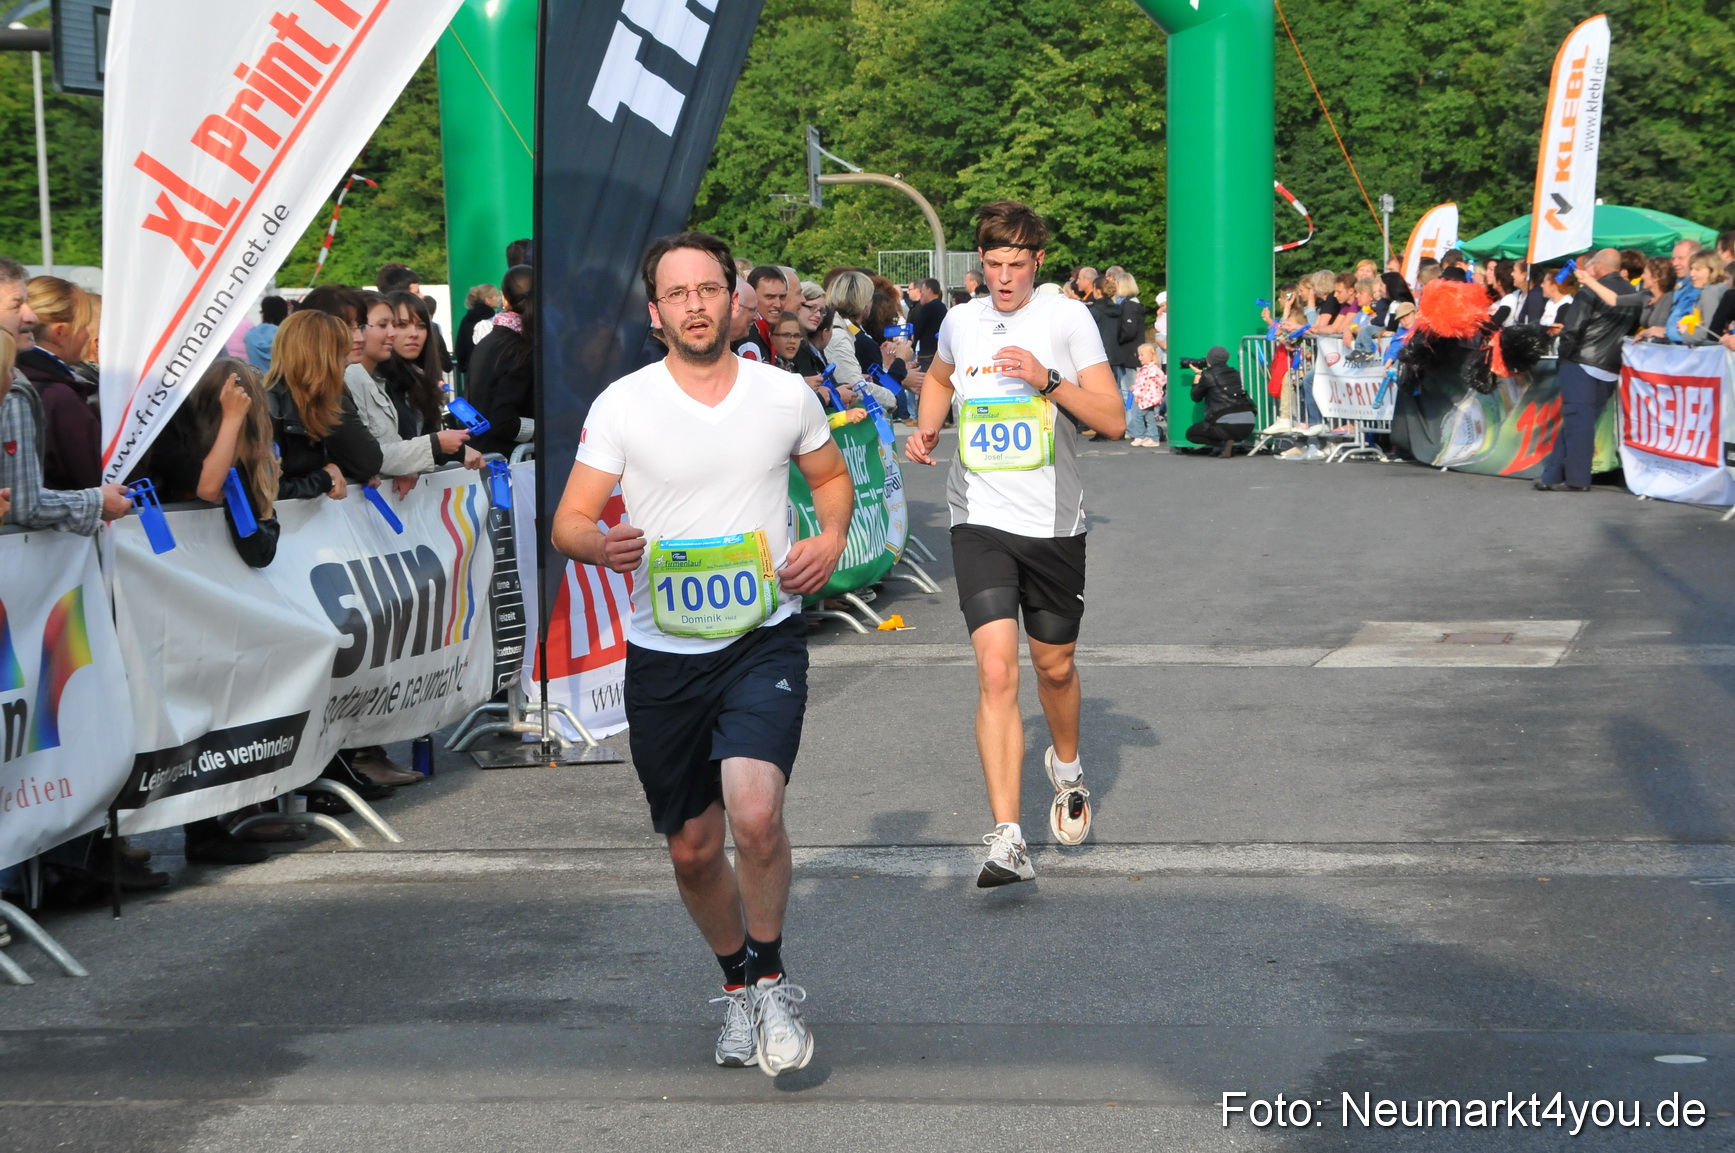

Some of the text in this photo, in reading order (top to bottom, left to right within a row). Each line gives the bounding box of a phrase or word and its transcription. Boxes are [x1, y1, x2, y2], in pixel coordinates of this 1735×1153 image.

[133, 11, 343, 271] XL Print
[1554, 44, 1590, 182] KLEBL
[1584, 57, 1605, 152] www.klebl.de
[970, 422, 1032, 452] 490
[1629, 377, 1714, 459] MEIER
[310, 544, 447, 679] swn
[657, 570, 757, 612] 1000
[681, 613, 722, 624] Dominik
[198, 749, 230, 773] die
[230, 734, 295, 766] verbinden
